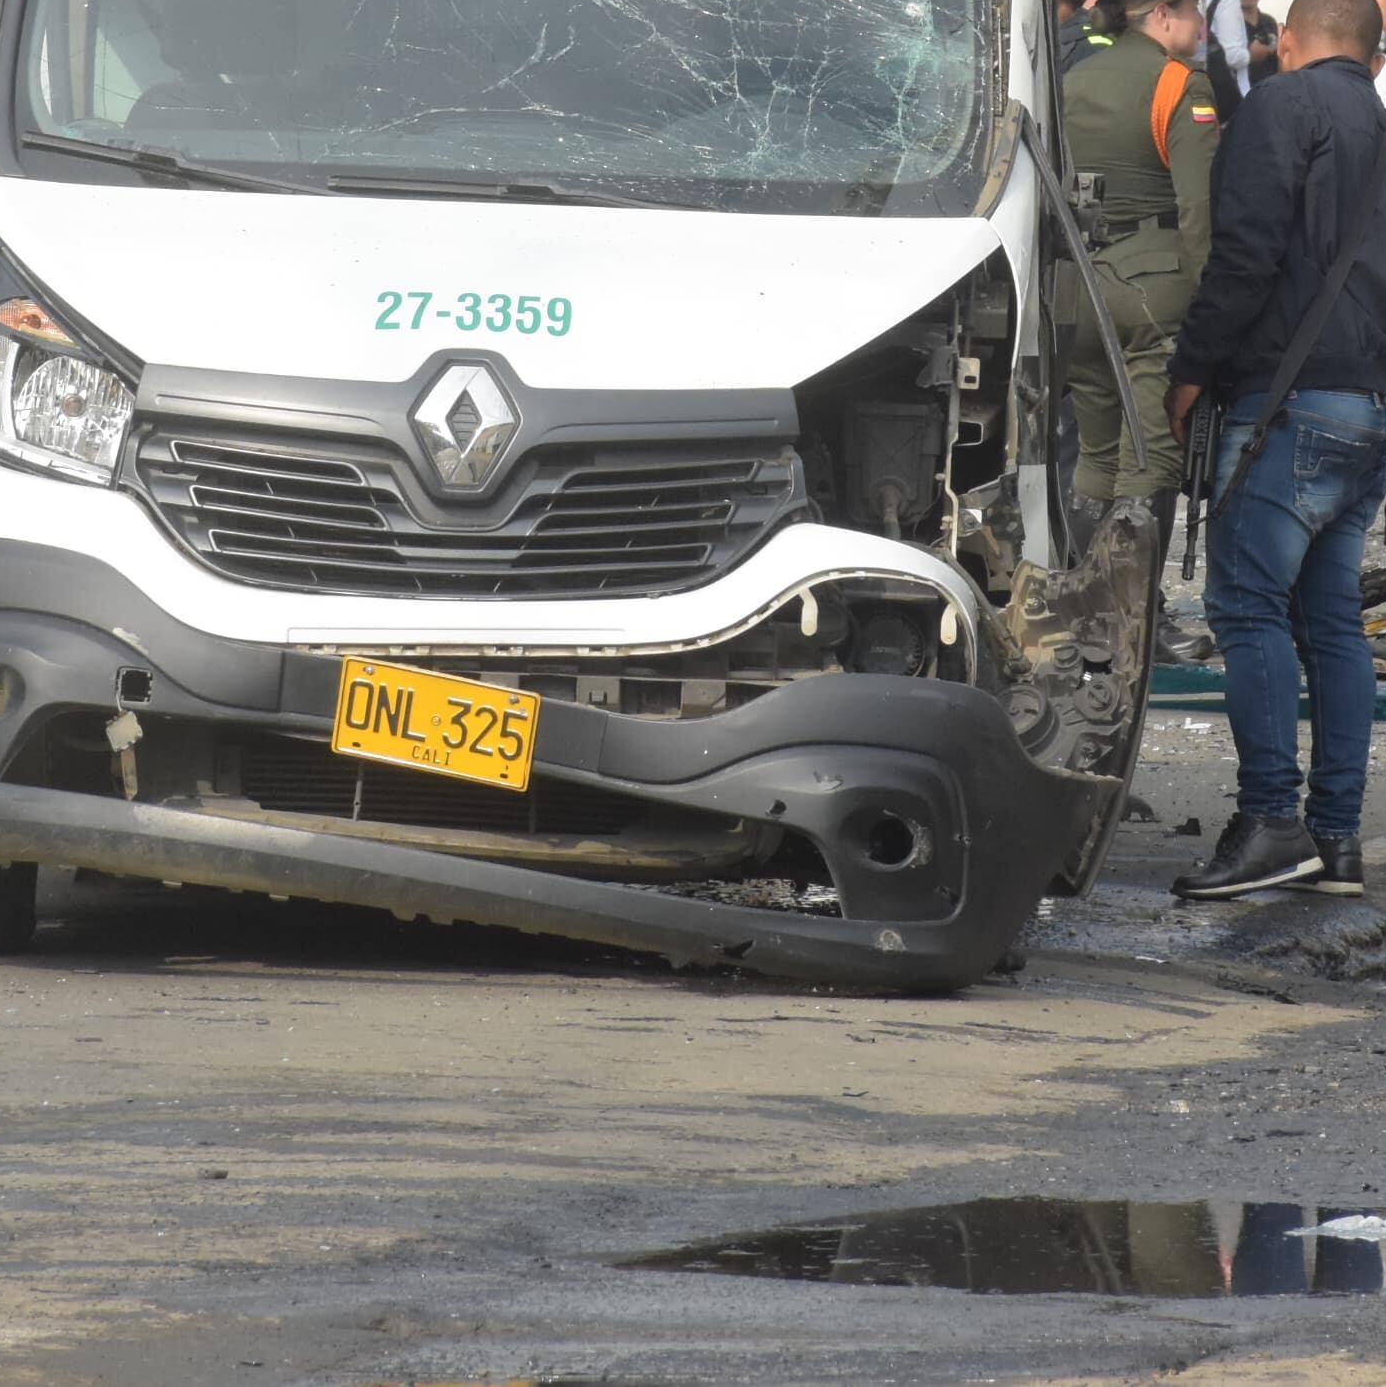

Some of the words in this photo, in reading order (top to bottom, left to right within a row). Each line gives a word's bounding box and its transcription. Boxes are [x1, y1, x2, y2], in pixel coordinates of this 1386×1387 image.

[374, 290, 573, 337] 27-3359
[345, 678, 426, 742] ONL
[442, 697, 530, 762] 325
[411, 745, 452, 766] CALI
